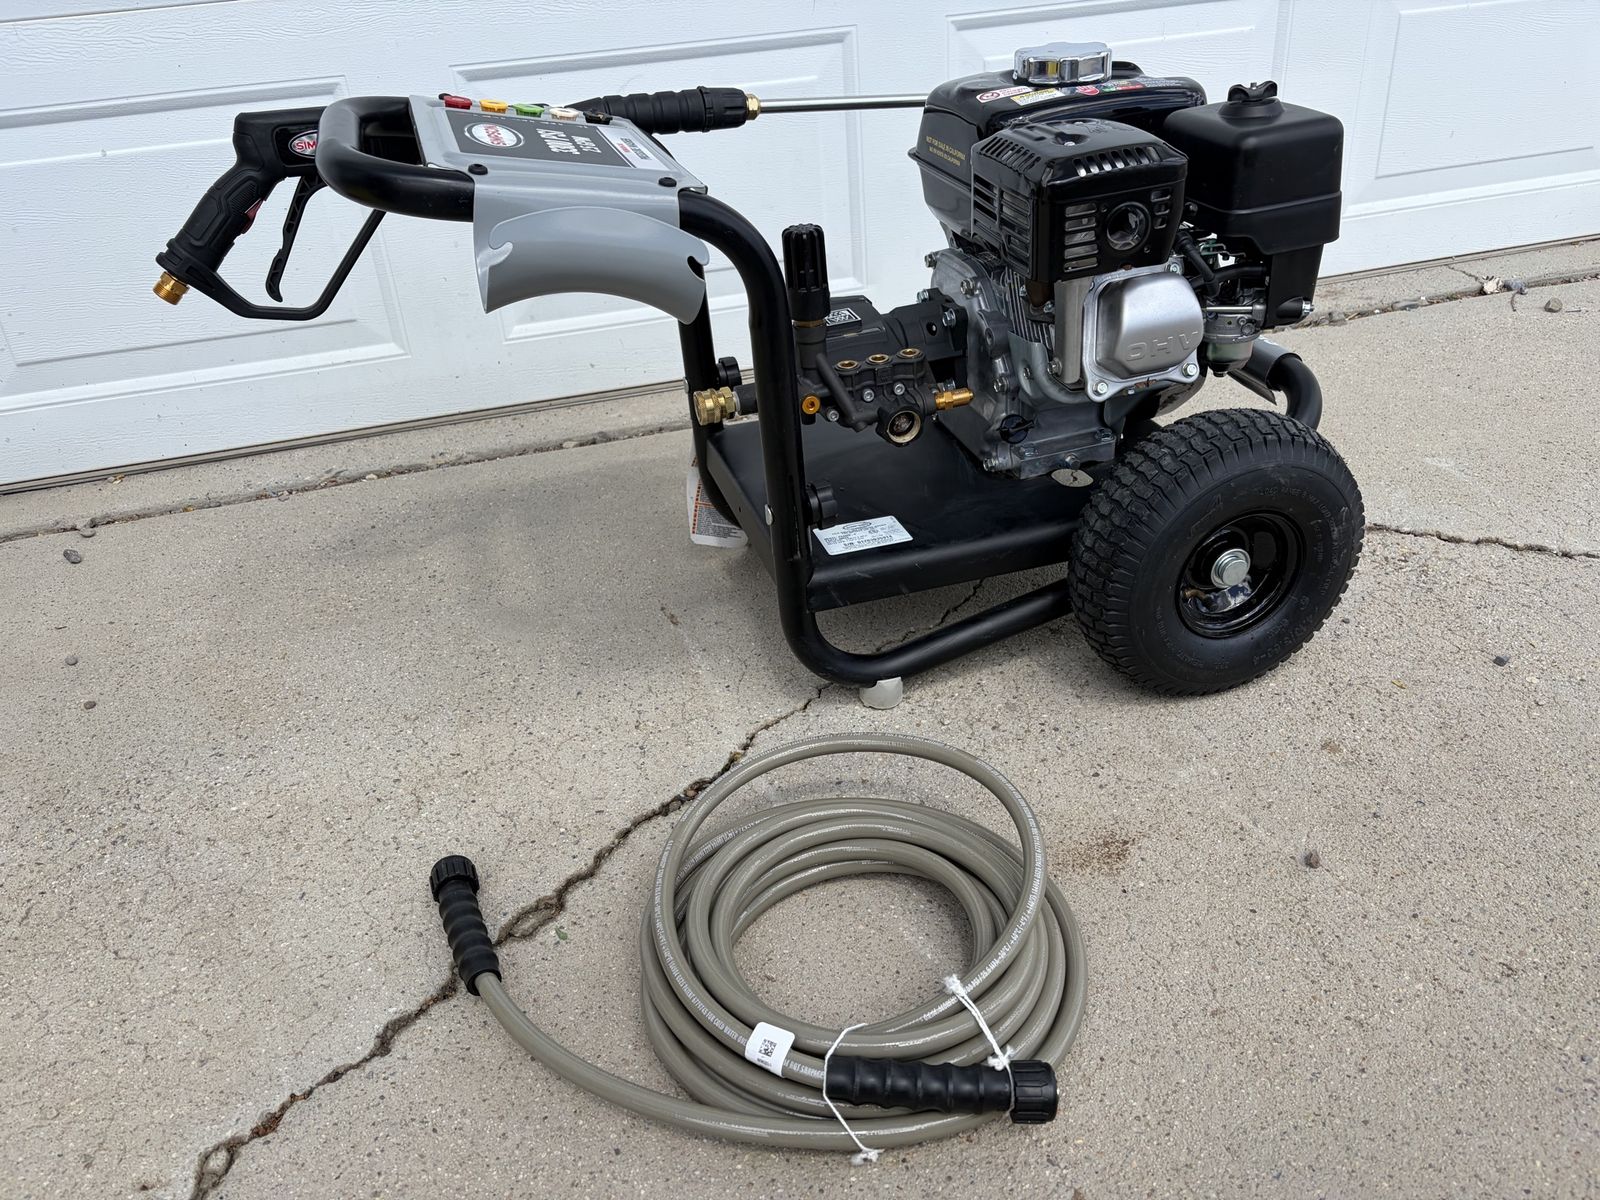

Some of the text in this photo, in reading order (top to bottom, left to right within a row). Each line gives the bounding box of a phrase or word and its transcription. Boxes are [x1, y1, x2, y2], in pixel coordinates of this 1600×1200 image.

[535, 128, 570, 141] PSI
[1126, 331, 1199, 361] OHV
[711, 1017, 726, 1031] COLD
